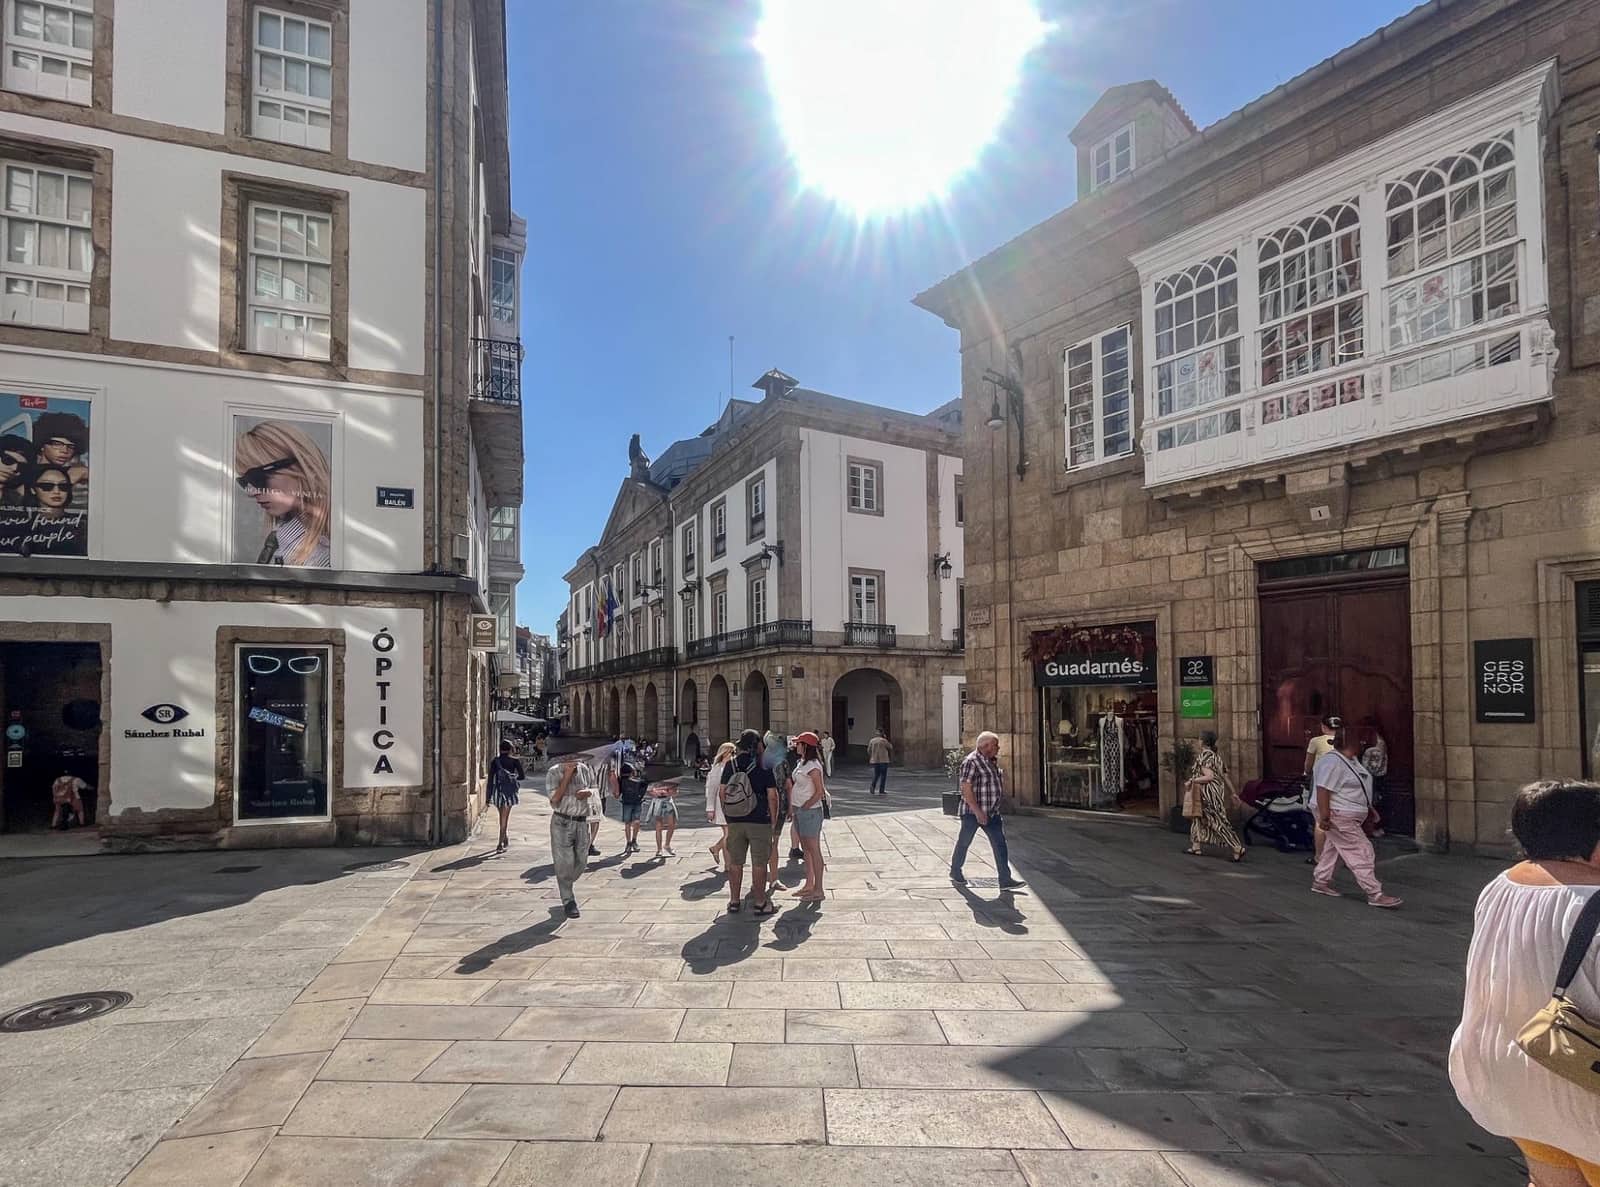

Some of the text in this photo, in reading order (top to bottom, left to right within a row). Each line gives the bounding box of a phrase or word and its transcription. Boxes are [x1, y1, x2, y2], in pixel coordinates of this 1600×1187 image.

[32, 513, 82, 529] found
[22, 527, 75, 548] people
[1045, 657, 1144, 676] Guadarnés
[1483, 660, 1524, 672] GES
[1483, 672, 1524, 683] PRO
[1483, 683, 1524, 694] NOR
[372, 627, 395, 774] ÓPTICA
[158, 709, 172, 718] SR
[124, 728, 205, 738] Sánchez Rubal
